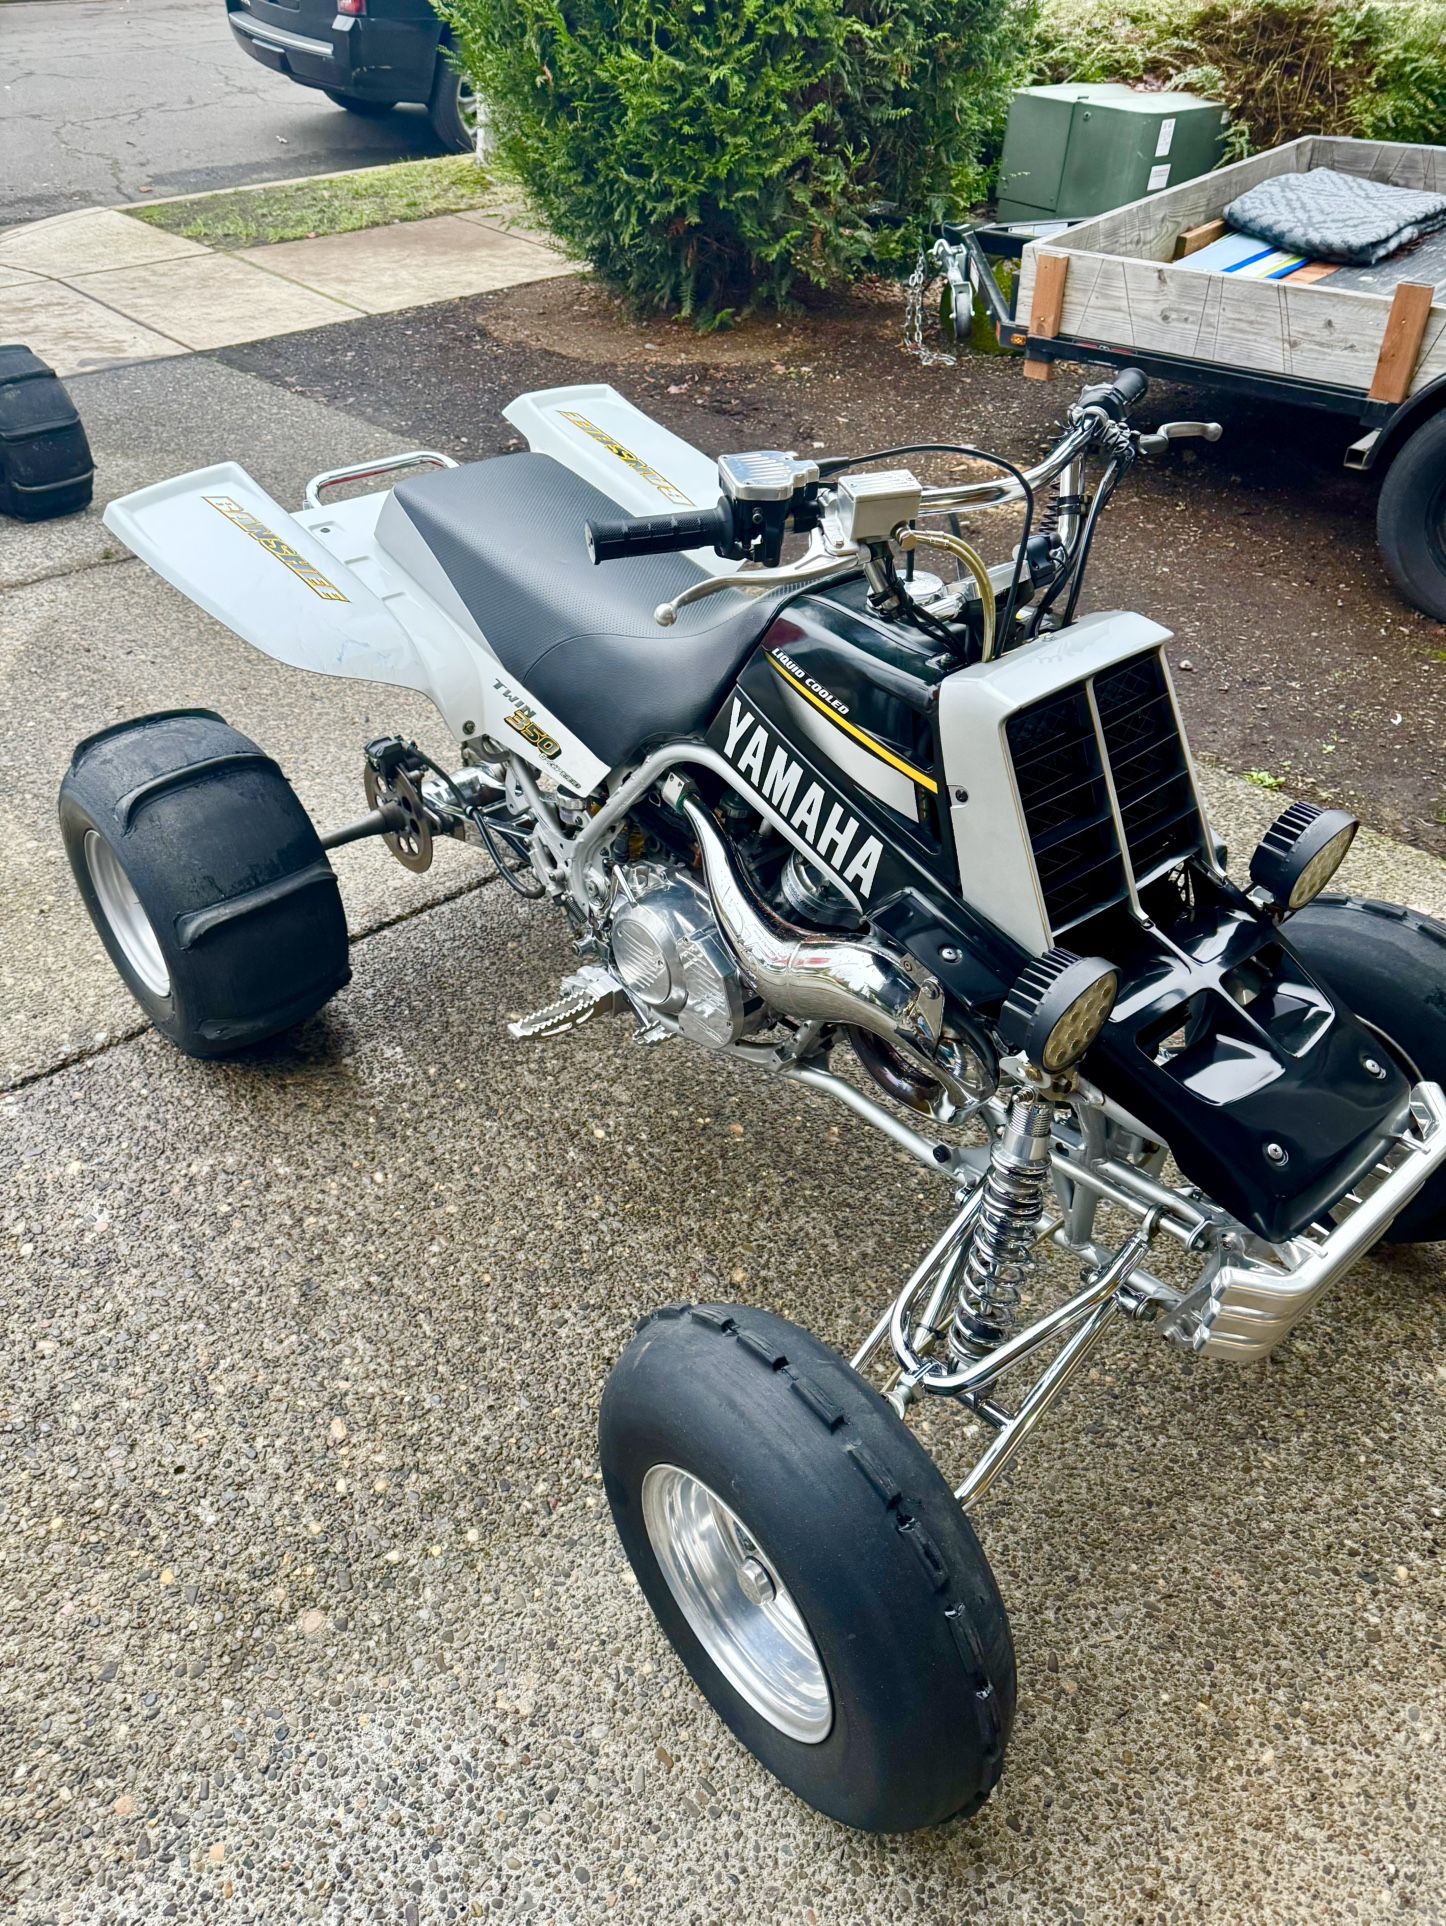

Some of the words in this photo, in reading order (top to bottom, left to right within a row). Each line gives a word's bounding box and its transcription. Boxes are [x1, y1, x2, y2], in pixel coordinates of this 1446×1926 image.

[202, 496, 351, 602] BANSHEE
[493, 678, 537, 718] TWIN
[771, 648, 805, 678] LIQUID
[805, 678, 850, 715] COOLED
[503, 709, 562, 760] 350
[724, 696, 883, 899] YAMAHA
